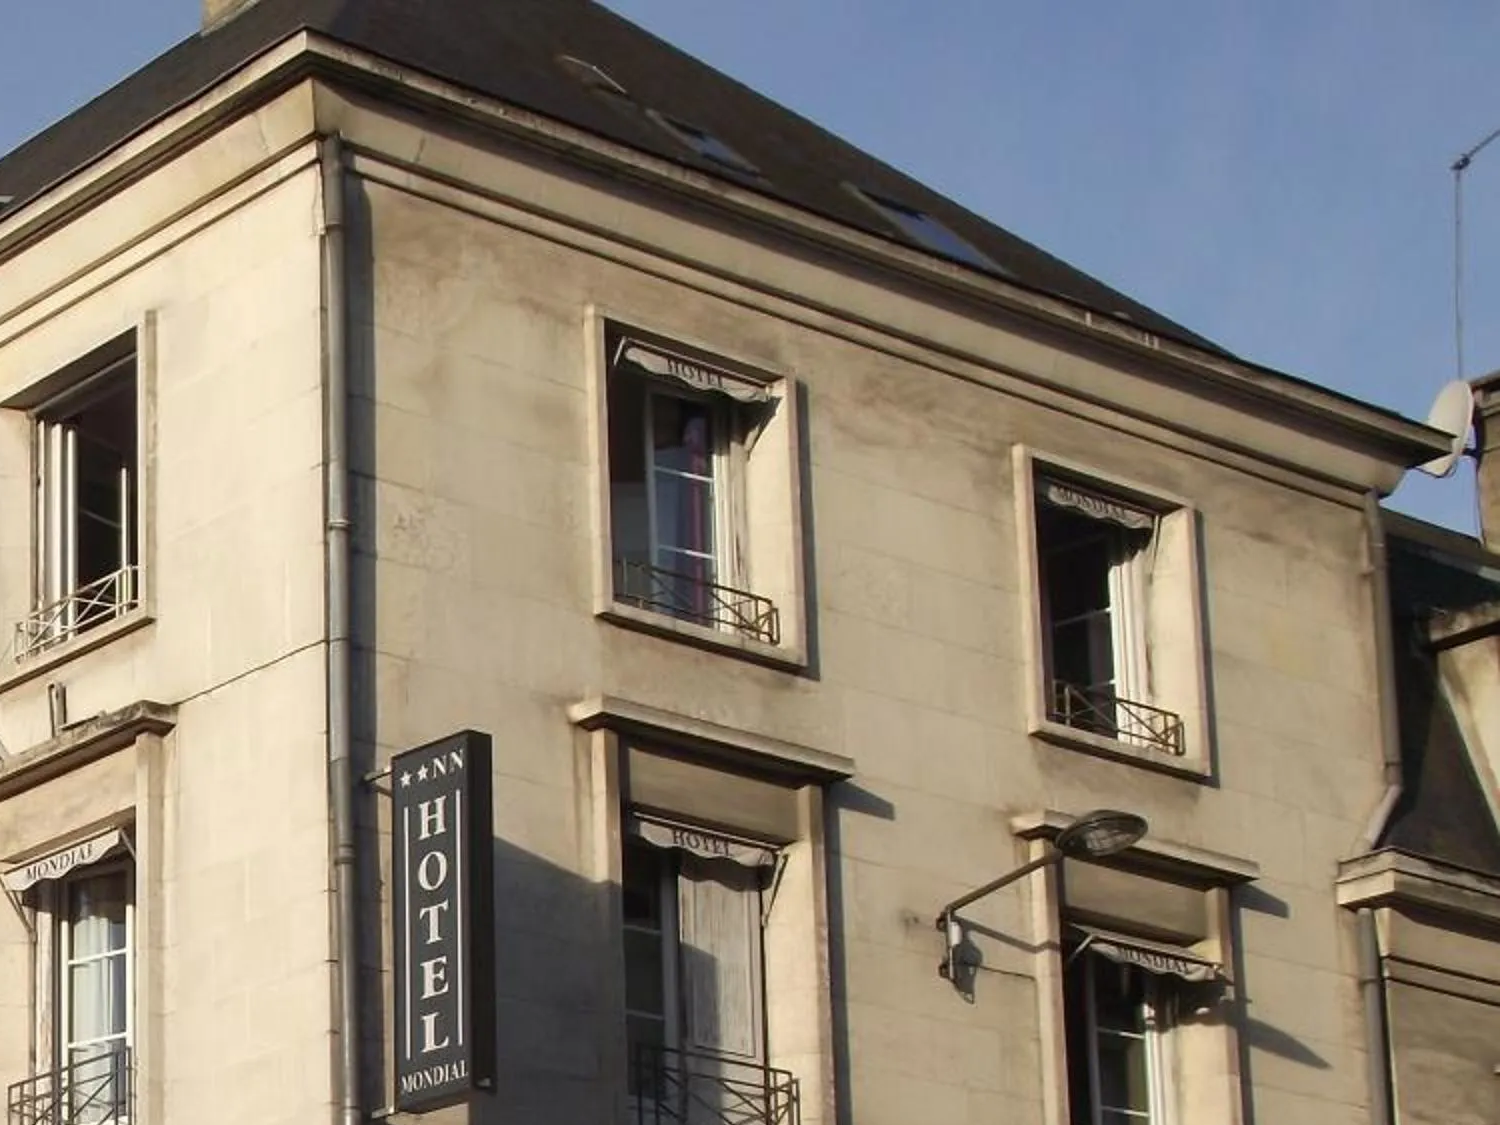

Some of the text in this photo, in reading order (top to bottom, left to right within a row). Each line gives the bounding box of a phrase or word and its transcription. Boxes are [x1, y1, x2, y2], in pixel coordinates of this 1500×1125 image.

[671, 828, 733, 857] HOTEL
[25, 843, 94, 882] MONDIAL
[417, 793, 451, 1055] HOTEL
[400, 1058, 470, 1095] MONDIAL
